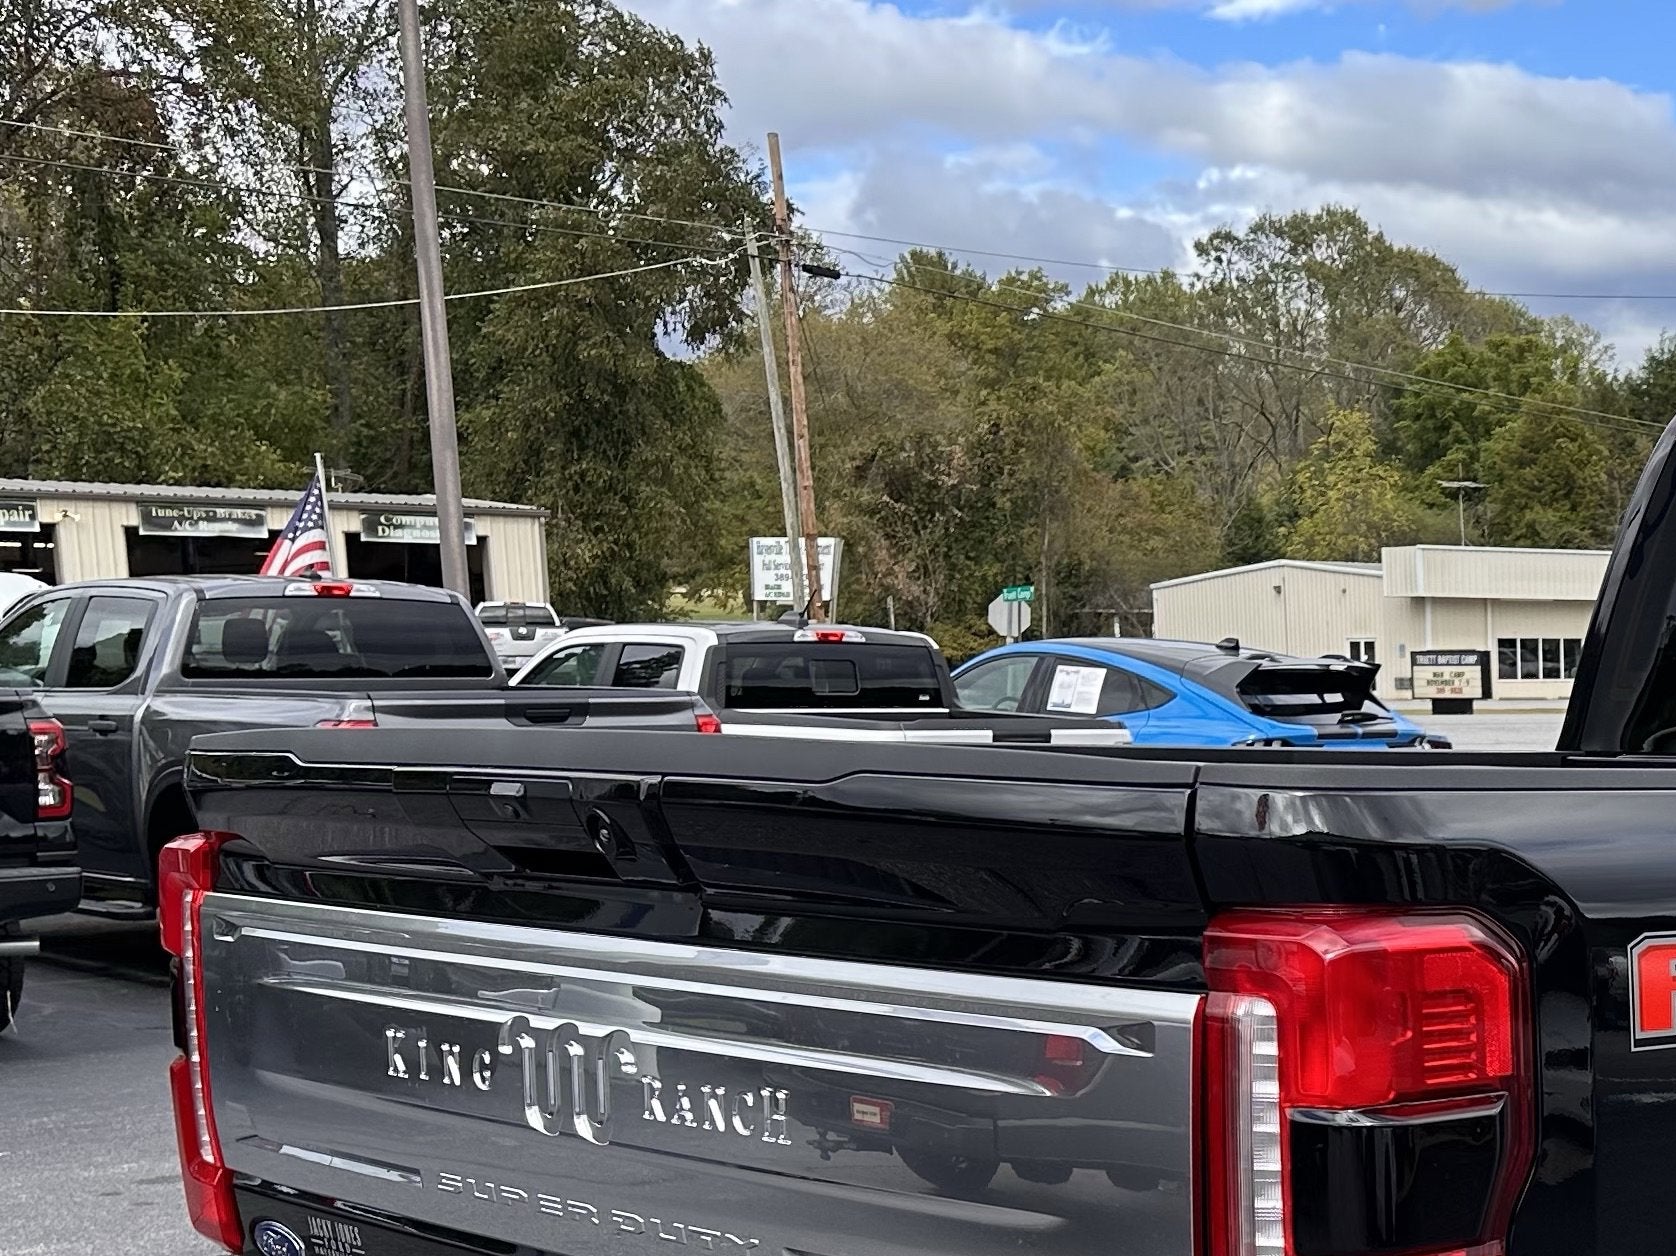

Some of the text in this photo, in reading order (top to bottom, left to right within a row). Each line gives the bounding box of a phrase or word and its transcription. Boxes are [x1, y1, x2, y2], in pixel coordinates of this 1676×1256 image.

[151, 506, 206, 520] Tune-Ups
[384, 1023, 792, 1146] KING RANCH
[437, 1172, 600, 1225] SUPER
[308, 1215, 361, 1246] JACKY JONES
[324, 1238, 351, 1254] FORD
